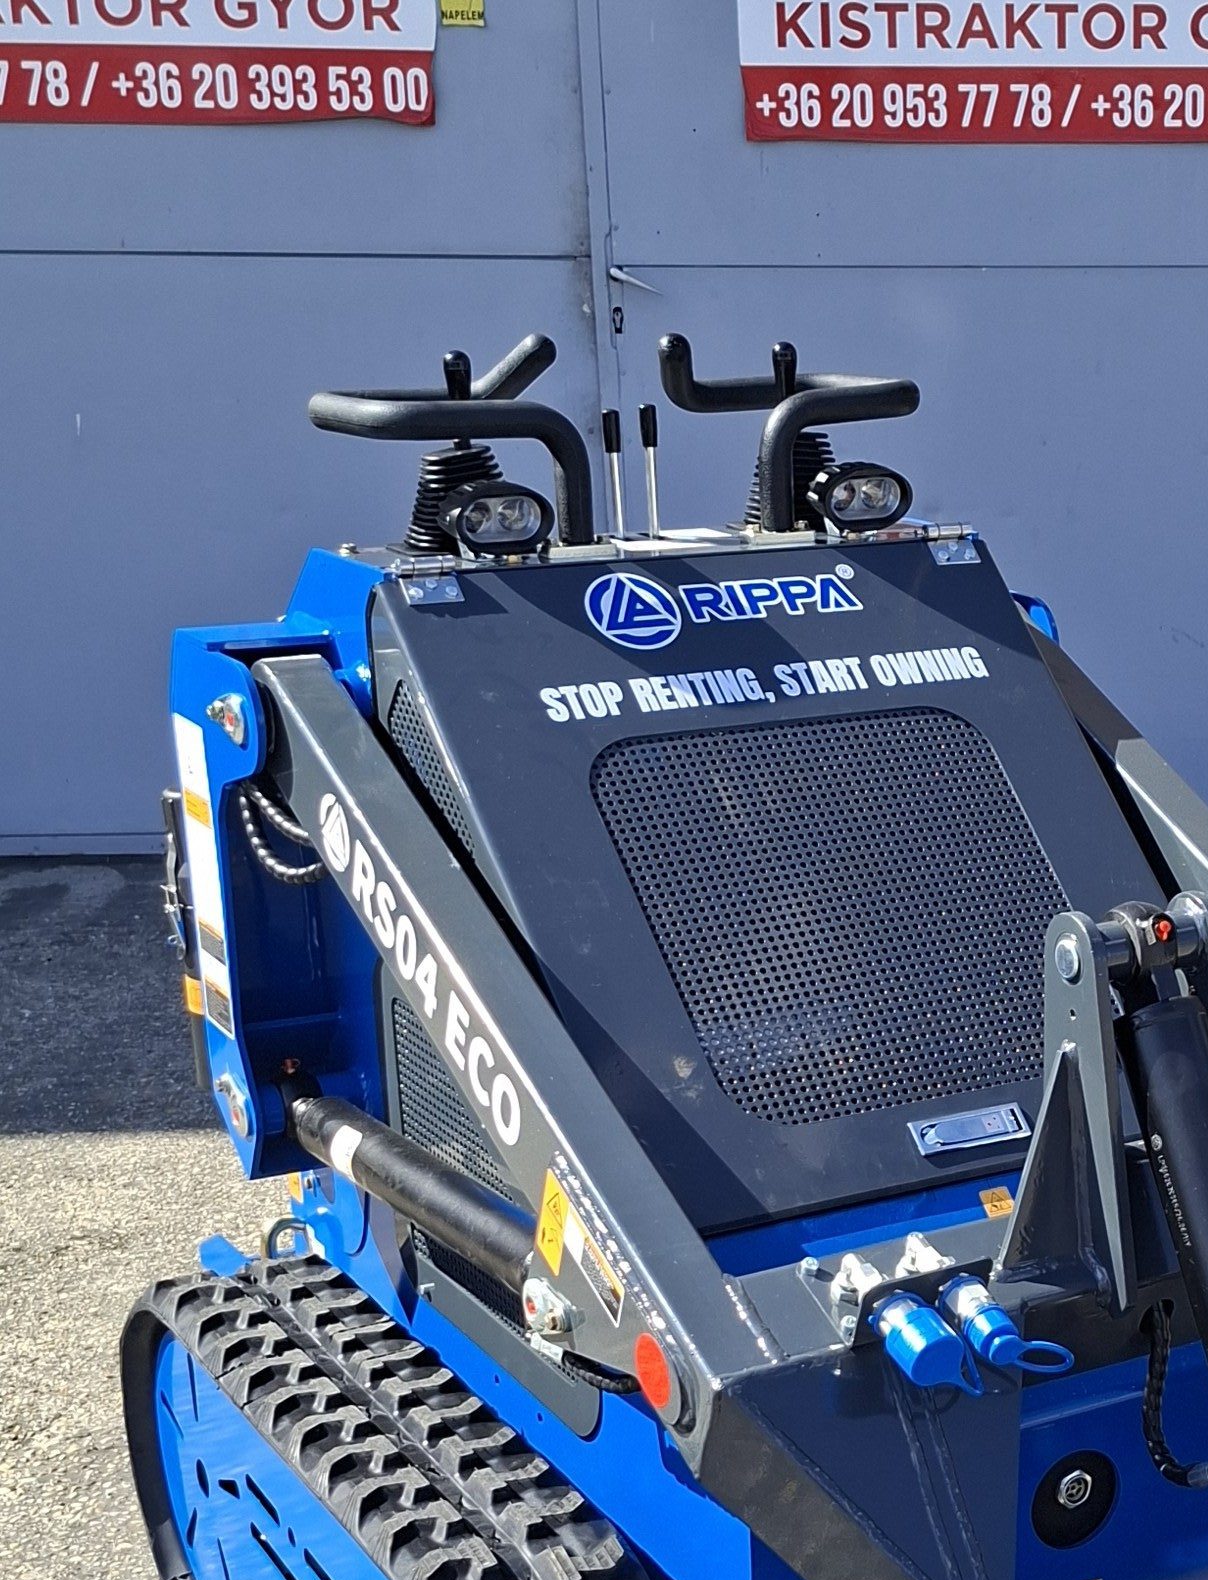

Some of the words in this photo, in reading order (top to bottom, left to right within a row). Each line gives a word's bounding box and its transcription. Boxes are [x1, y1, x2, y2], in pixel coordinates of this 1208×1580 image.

[0, 0, 191, 27] KTOR
[775, 2, 1168, 50] KISTRAKTOR
[20, 60, 70, 107] 78
[80, 61, 99, 107] /
[111, 61, 182, 109] +36
[192, 63, 239, 109] 20
[248, 64, 318, 111] 393
[328, 66, 374, 112] 53
[383, 67, 429, 113] 00
[756, 82, 822, 128] +36
[831, 83, 874, 128] 20
[883, 83, 948, 128] 953
[957, 84, 1000, 128] 77
[1009, 84, 1052, 128] 78
[1061, 84, 1082, 127] /
[1091, 84, 1154, 128] +36
[1163, 84, 1205, 128] 20
[539, 681, 626, 722] STOP
[628, 667, 776, 712] RENTING,
[773, 656, 870, 695] START
[868, 646, 990, 688] OWNING
[351, 840, 439, 1020] RS04
[444, 989, 521, 1146] ECO
